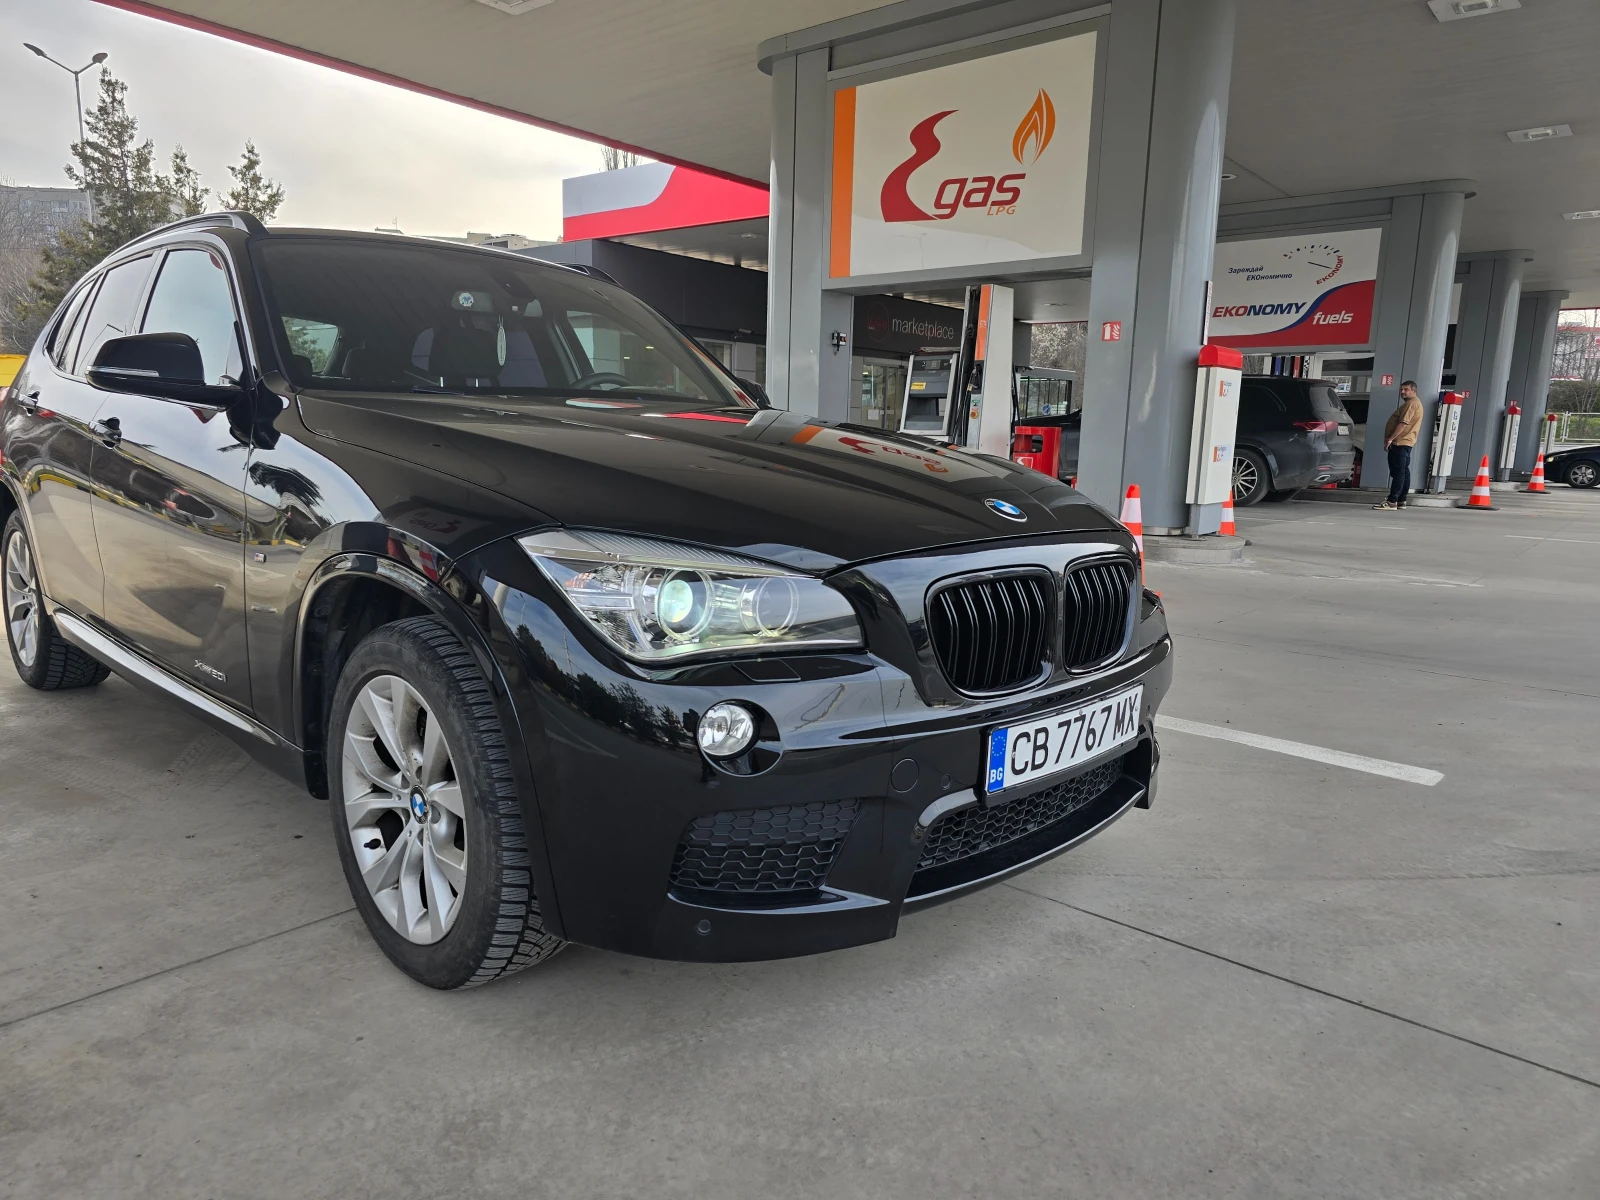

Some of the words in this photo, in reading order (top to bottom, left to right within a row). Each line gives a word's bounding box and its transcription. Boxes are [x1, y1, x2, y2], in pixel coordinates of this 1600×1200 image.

[987, 205, 1016, 216] LPG
[1228, 265, 1264, 275] Зареждай
[1316, 255, 1343, 285] EKONOMY
[1212, 302, 1307, 318] EKONOMY
[1313, 310, 1354, 325] fuels
[892, 318, 954, 340] marketplace
[1011, 727, 1049, 776] CB
[1054, 705, 1112, 765] 7767
[1112, 693, 1138, 741] MX
[990, 767, 1003, 783] BG
